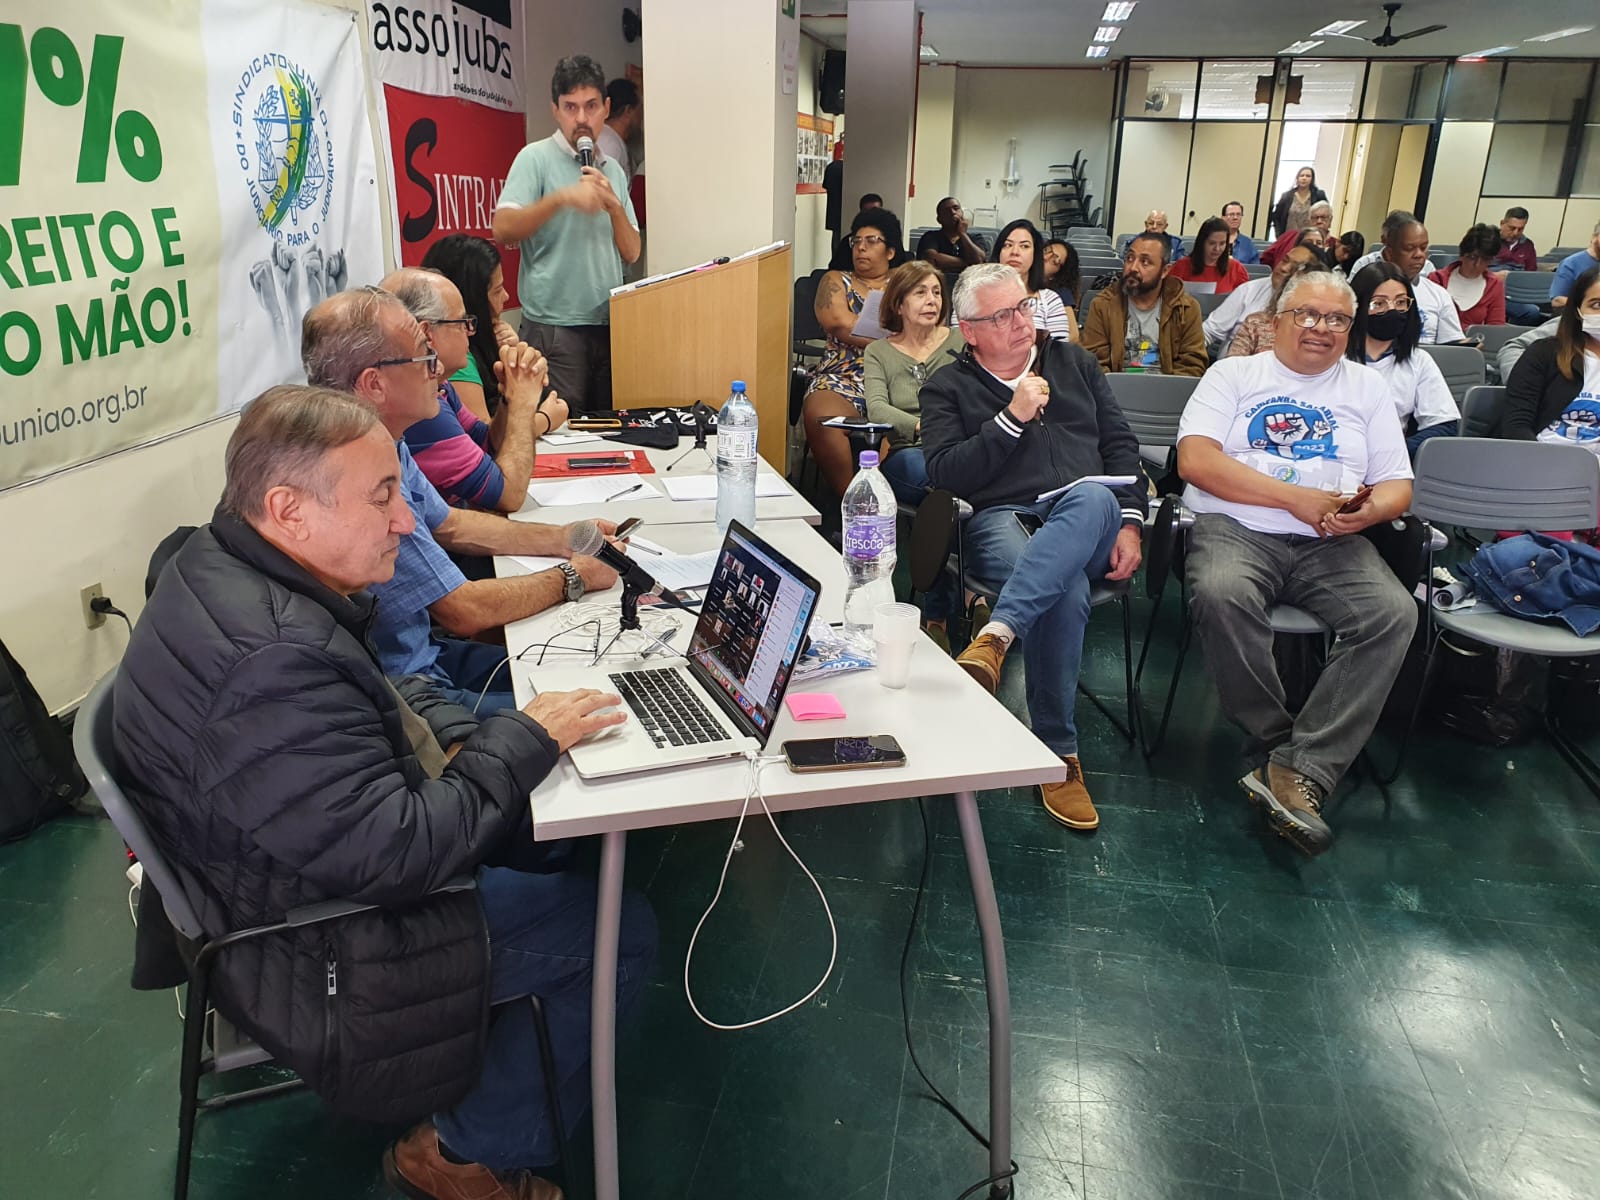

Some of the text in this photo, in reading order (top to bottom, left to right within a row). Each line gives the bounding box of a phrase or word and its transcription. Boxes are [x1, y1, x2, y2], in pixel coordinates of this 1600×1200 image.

[372, 2, 512, 80] assojubs
[233, 52, 288, 127] SINDICATO
[236, 143, 249, 171] DO
[287, 230, 310, 246] PARA
[312, 222, 319, 235] O
[402, 117, 506, 243] SINTRA
[151, 207, 185, 267] E
[56, 276, 192, 366] MÃO!
[0, 385, 148, 446] uniao.org.br
